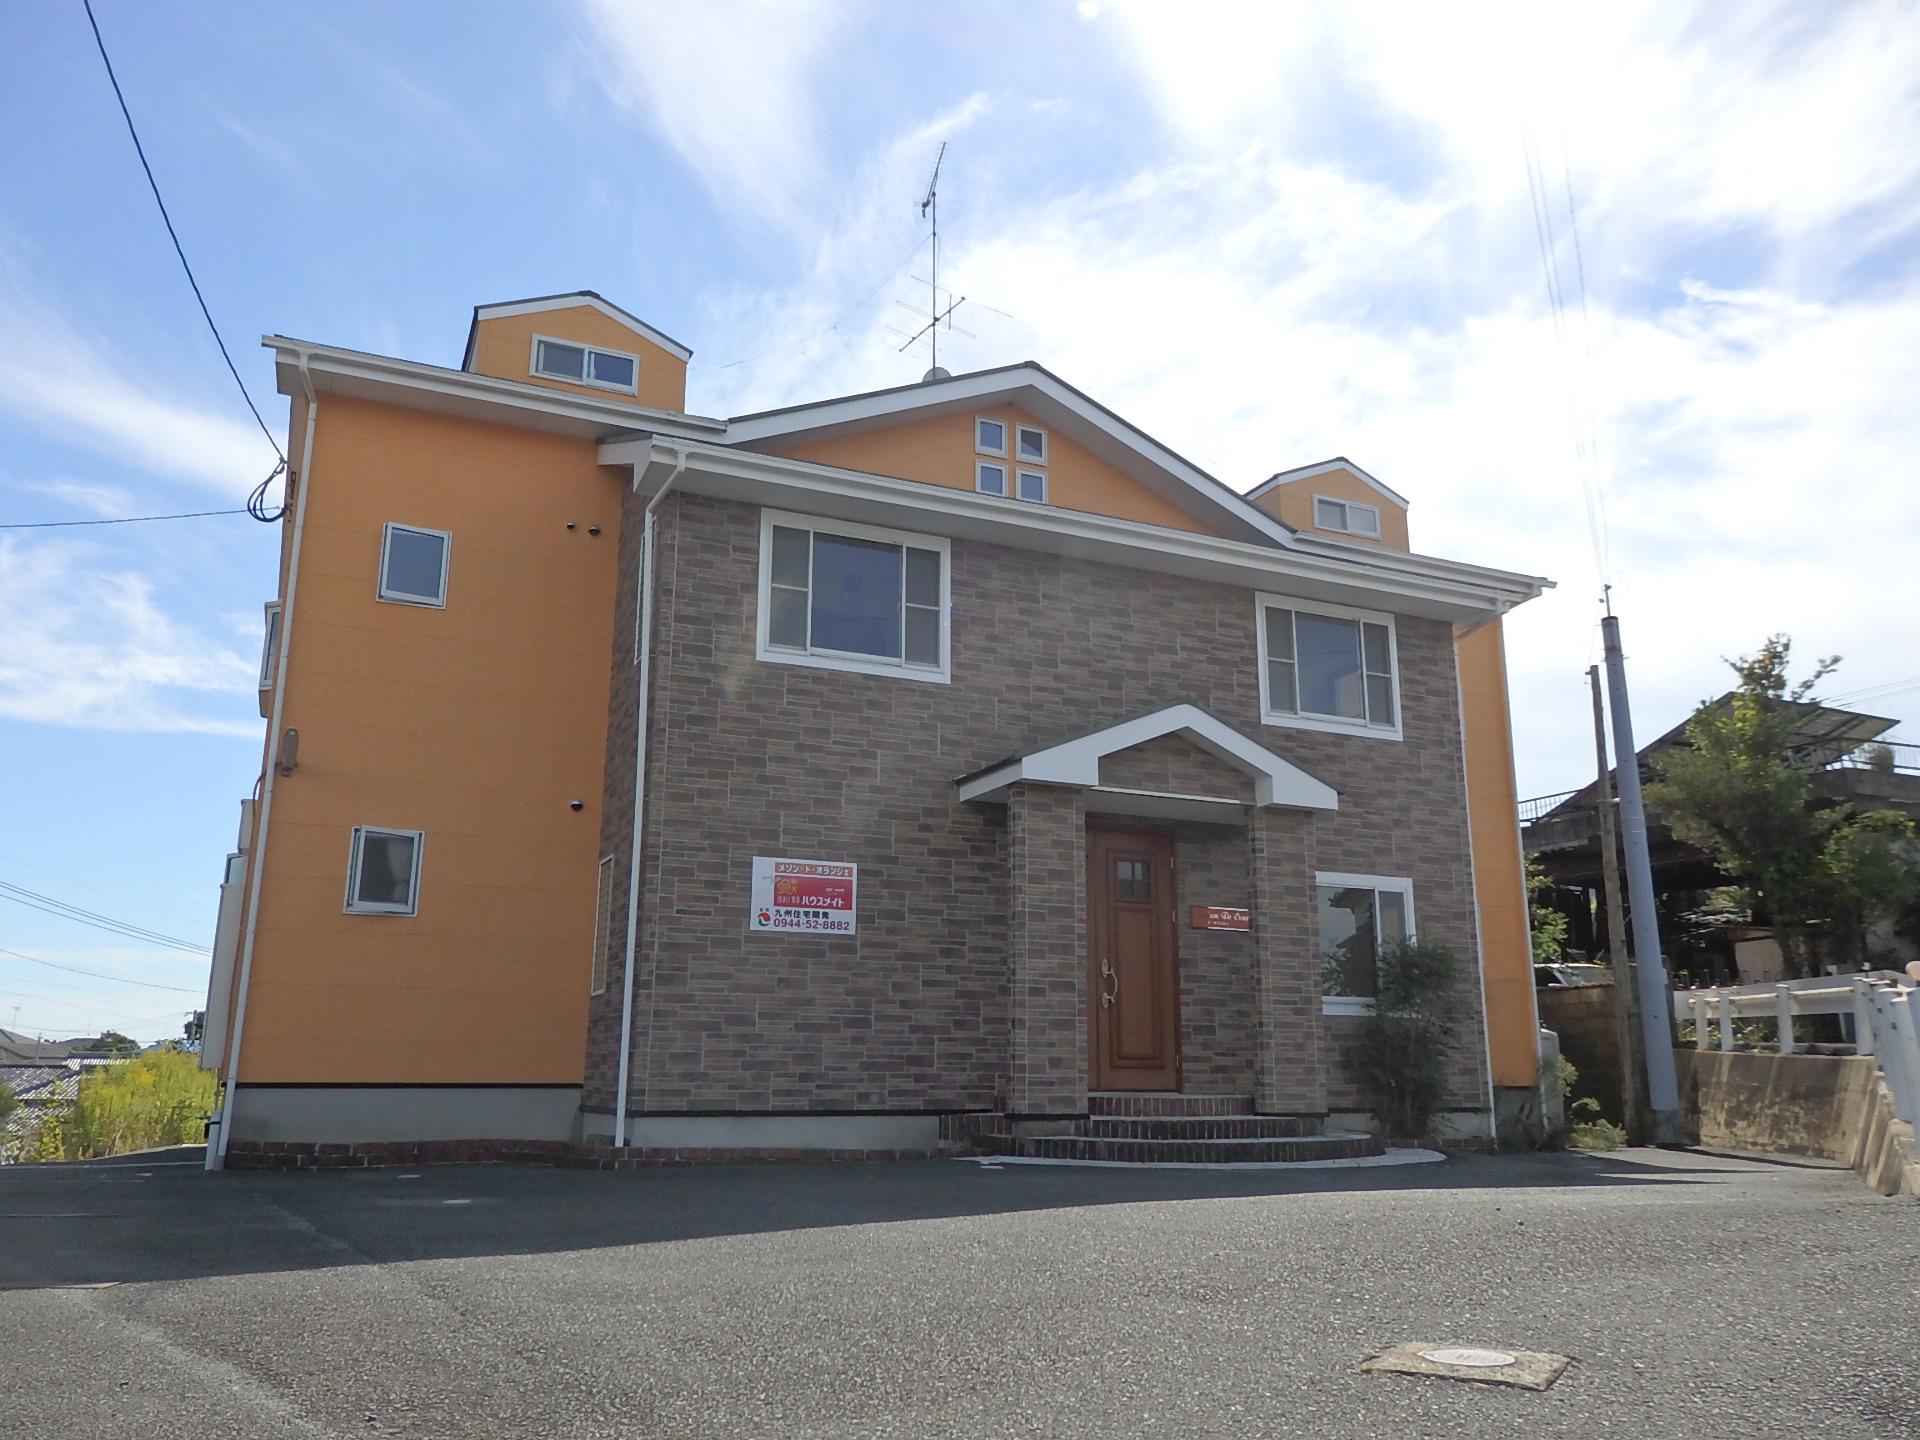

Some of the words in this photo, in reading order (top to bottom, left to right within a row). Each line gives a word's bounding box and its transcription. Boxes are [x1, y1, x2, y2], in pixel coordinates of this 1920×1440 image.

[802, 896, 844, 907] ハウスメイト
[775, 910, 830, 919] 九州住宅開発
[774, 918, 850, 930] 0944-52-8882
